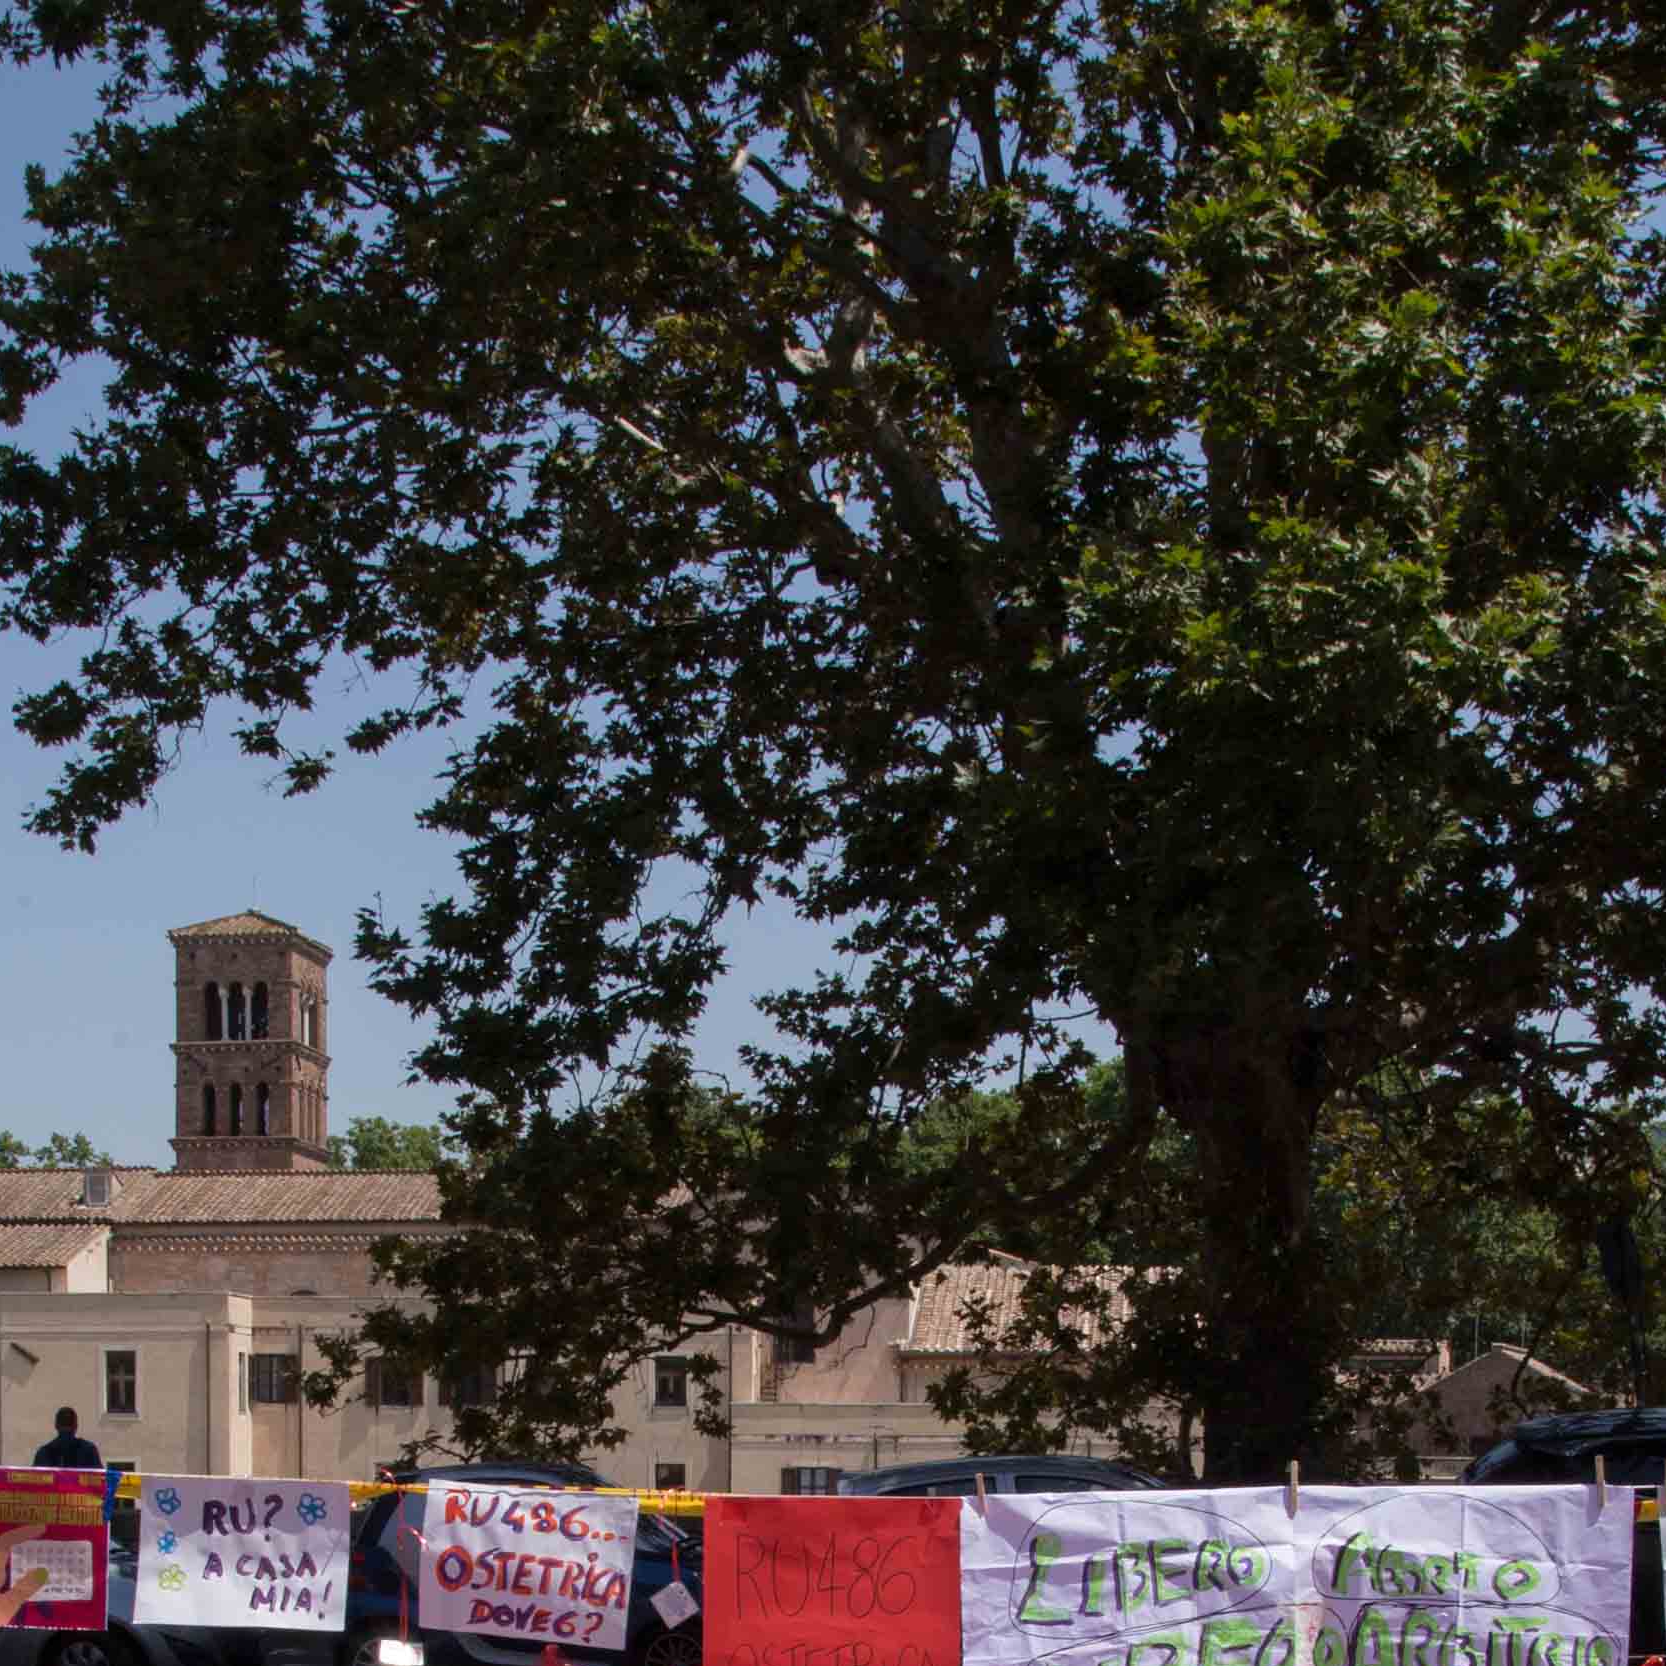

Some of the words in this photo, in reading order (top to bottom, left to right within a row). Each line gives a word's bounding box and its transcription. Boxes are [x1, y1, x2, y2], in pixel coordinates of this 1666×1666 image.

[202, 1494, 285, 1541] RU?
[204, 1553, 223, 1580] A
[735, 1531, 918, 1620] RU486
[1016, 1533, 1264, 1626] LIBERO
